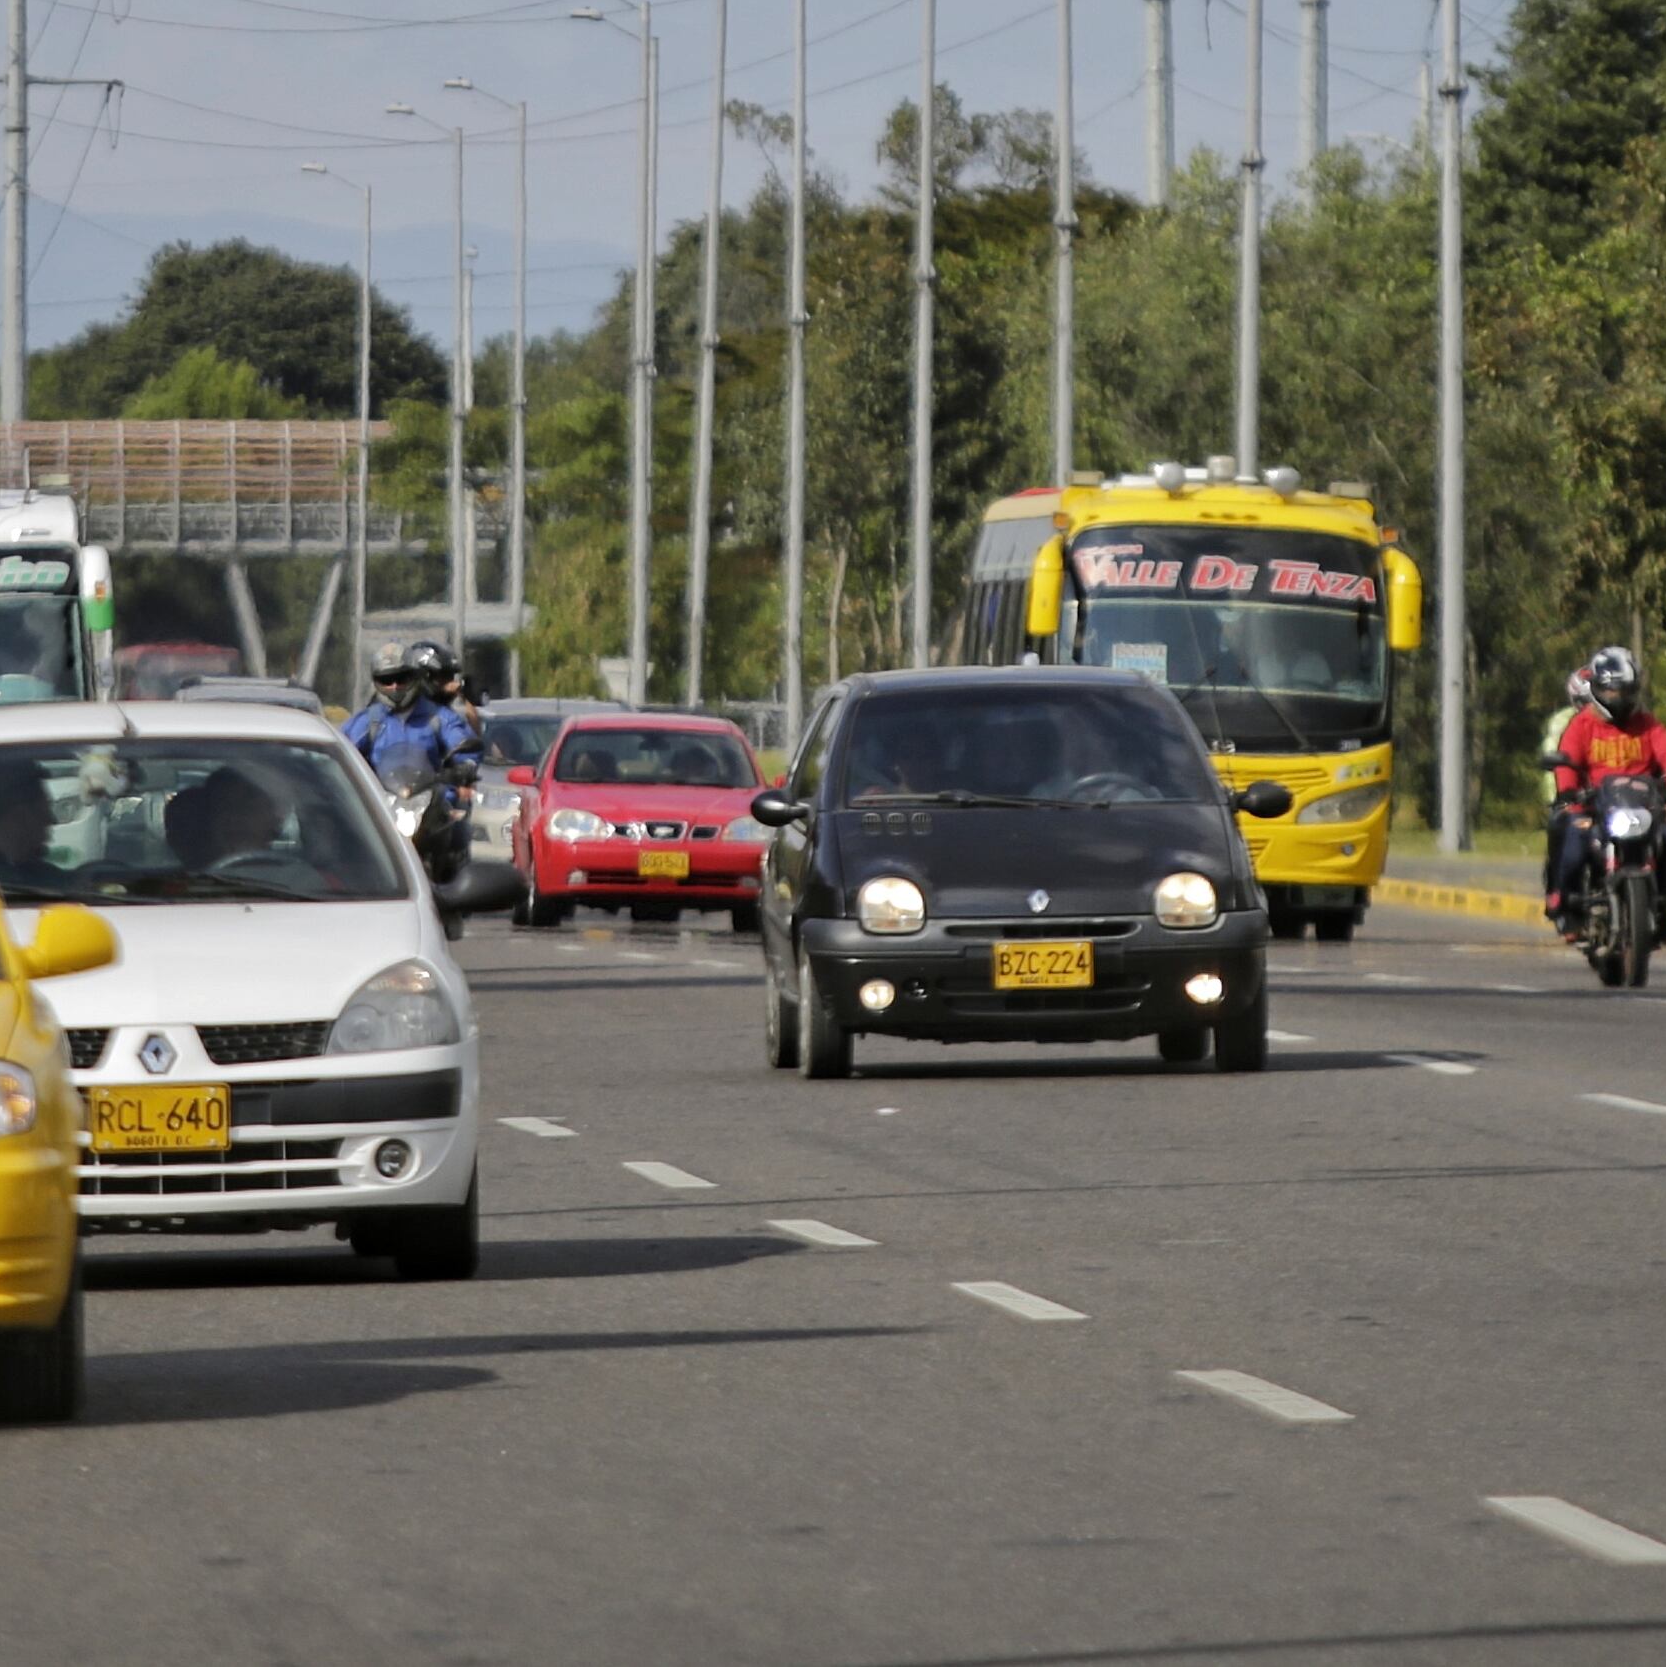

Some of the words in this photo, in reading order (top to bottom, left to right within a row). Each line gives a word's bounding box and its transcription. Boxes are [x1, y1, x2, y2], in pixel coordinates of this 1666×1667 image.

[1075, 554, 1183, 590] VALLE
[1190, 554, 1259, 591] DE
[1268, 558, 1377, 603] TENZA
